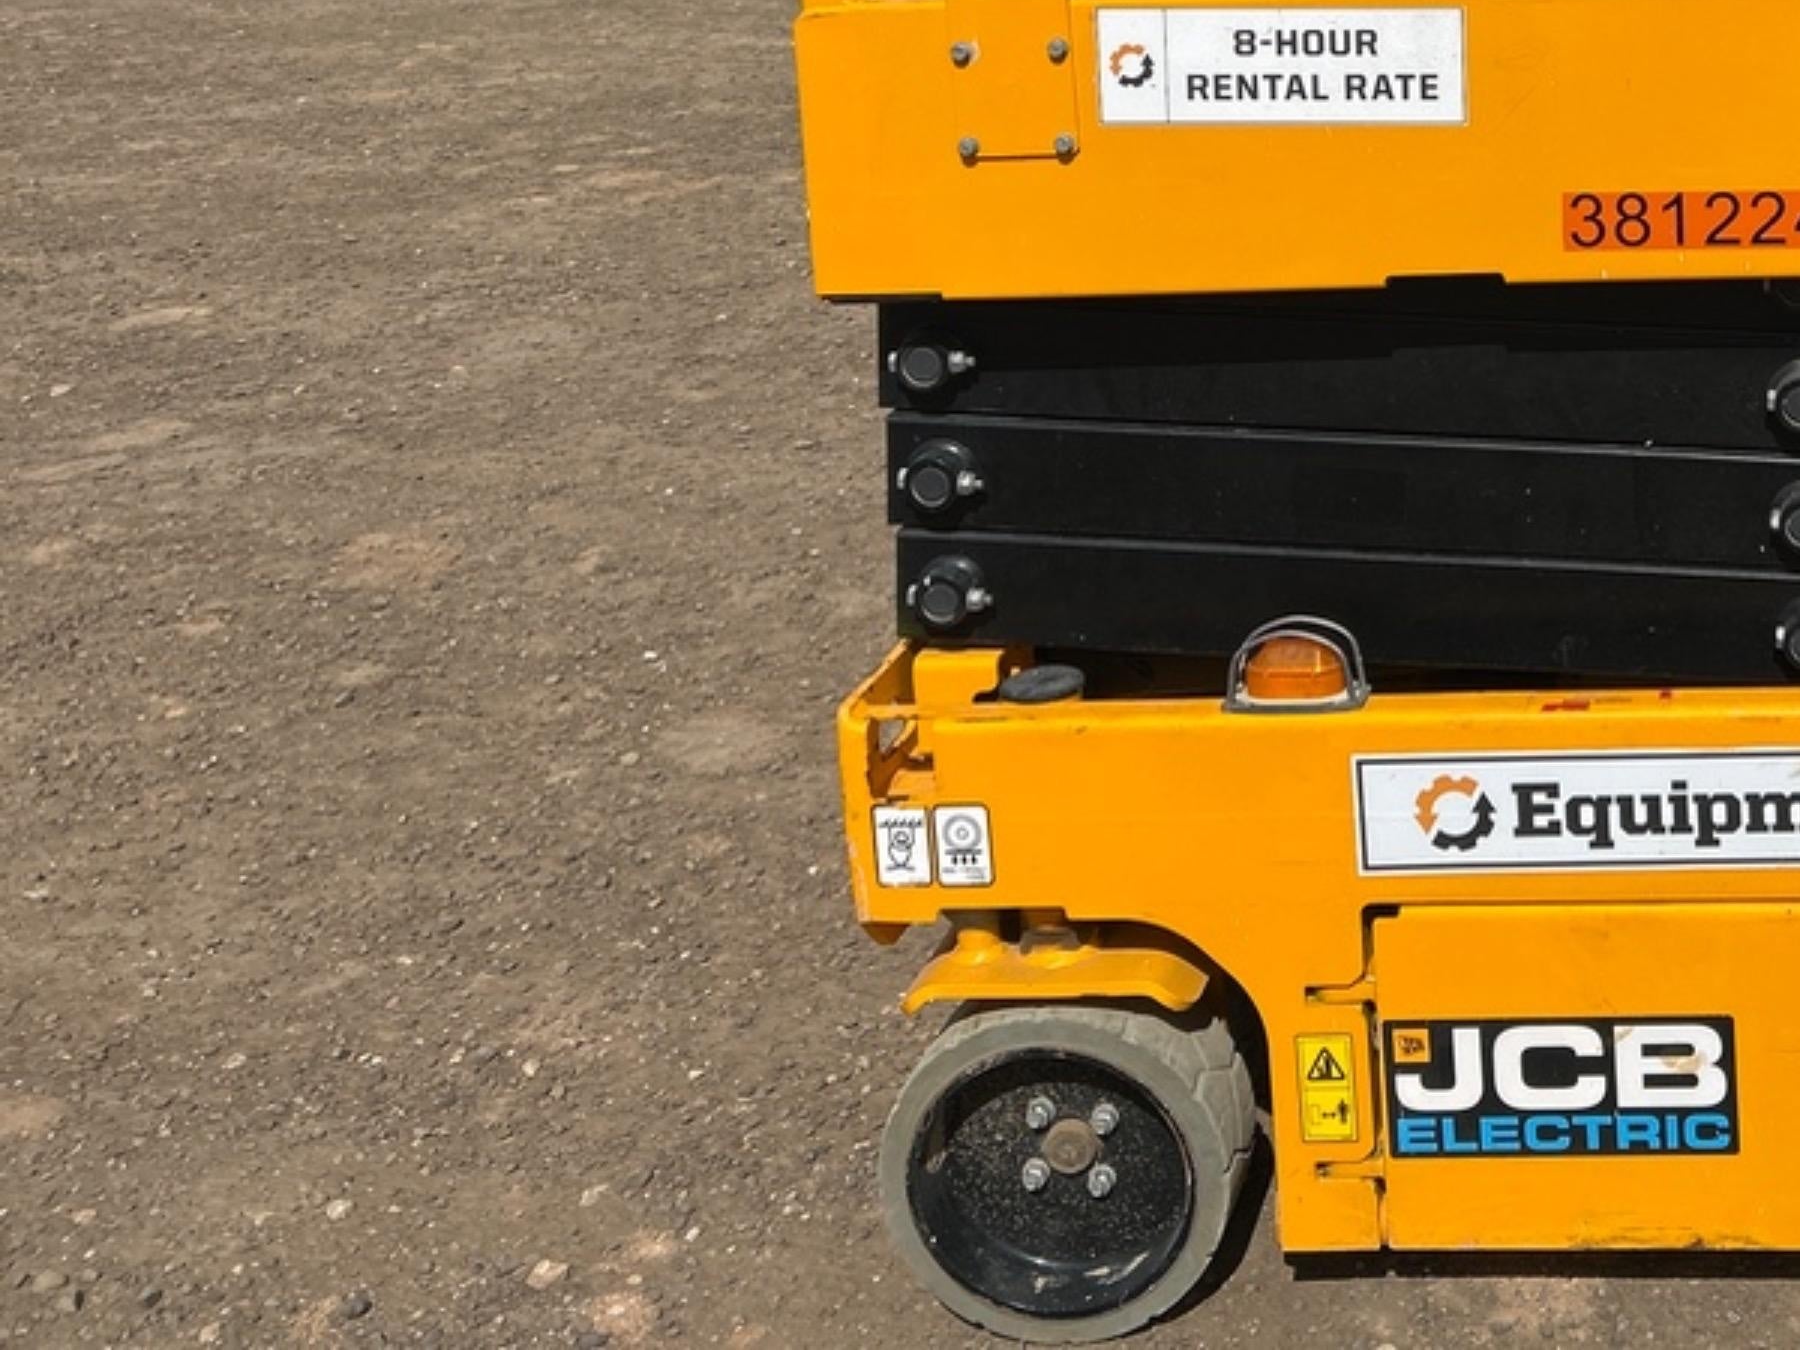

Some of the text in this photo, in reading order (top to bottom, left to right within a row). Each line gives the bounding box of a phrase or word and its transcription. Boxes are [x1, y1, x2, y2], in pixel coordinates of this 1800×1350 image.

[1233, 28, 1379, 57] 8-HOUR
[1186, 73, 1440, 101] RENTAL RATE
[1394, 1024, 1728, 1112] JCB
[1398, 1113, 1730, 1154] ELECTRIC
